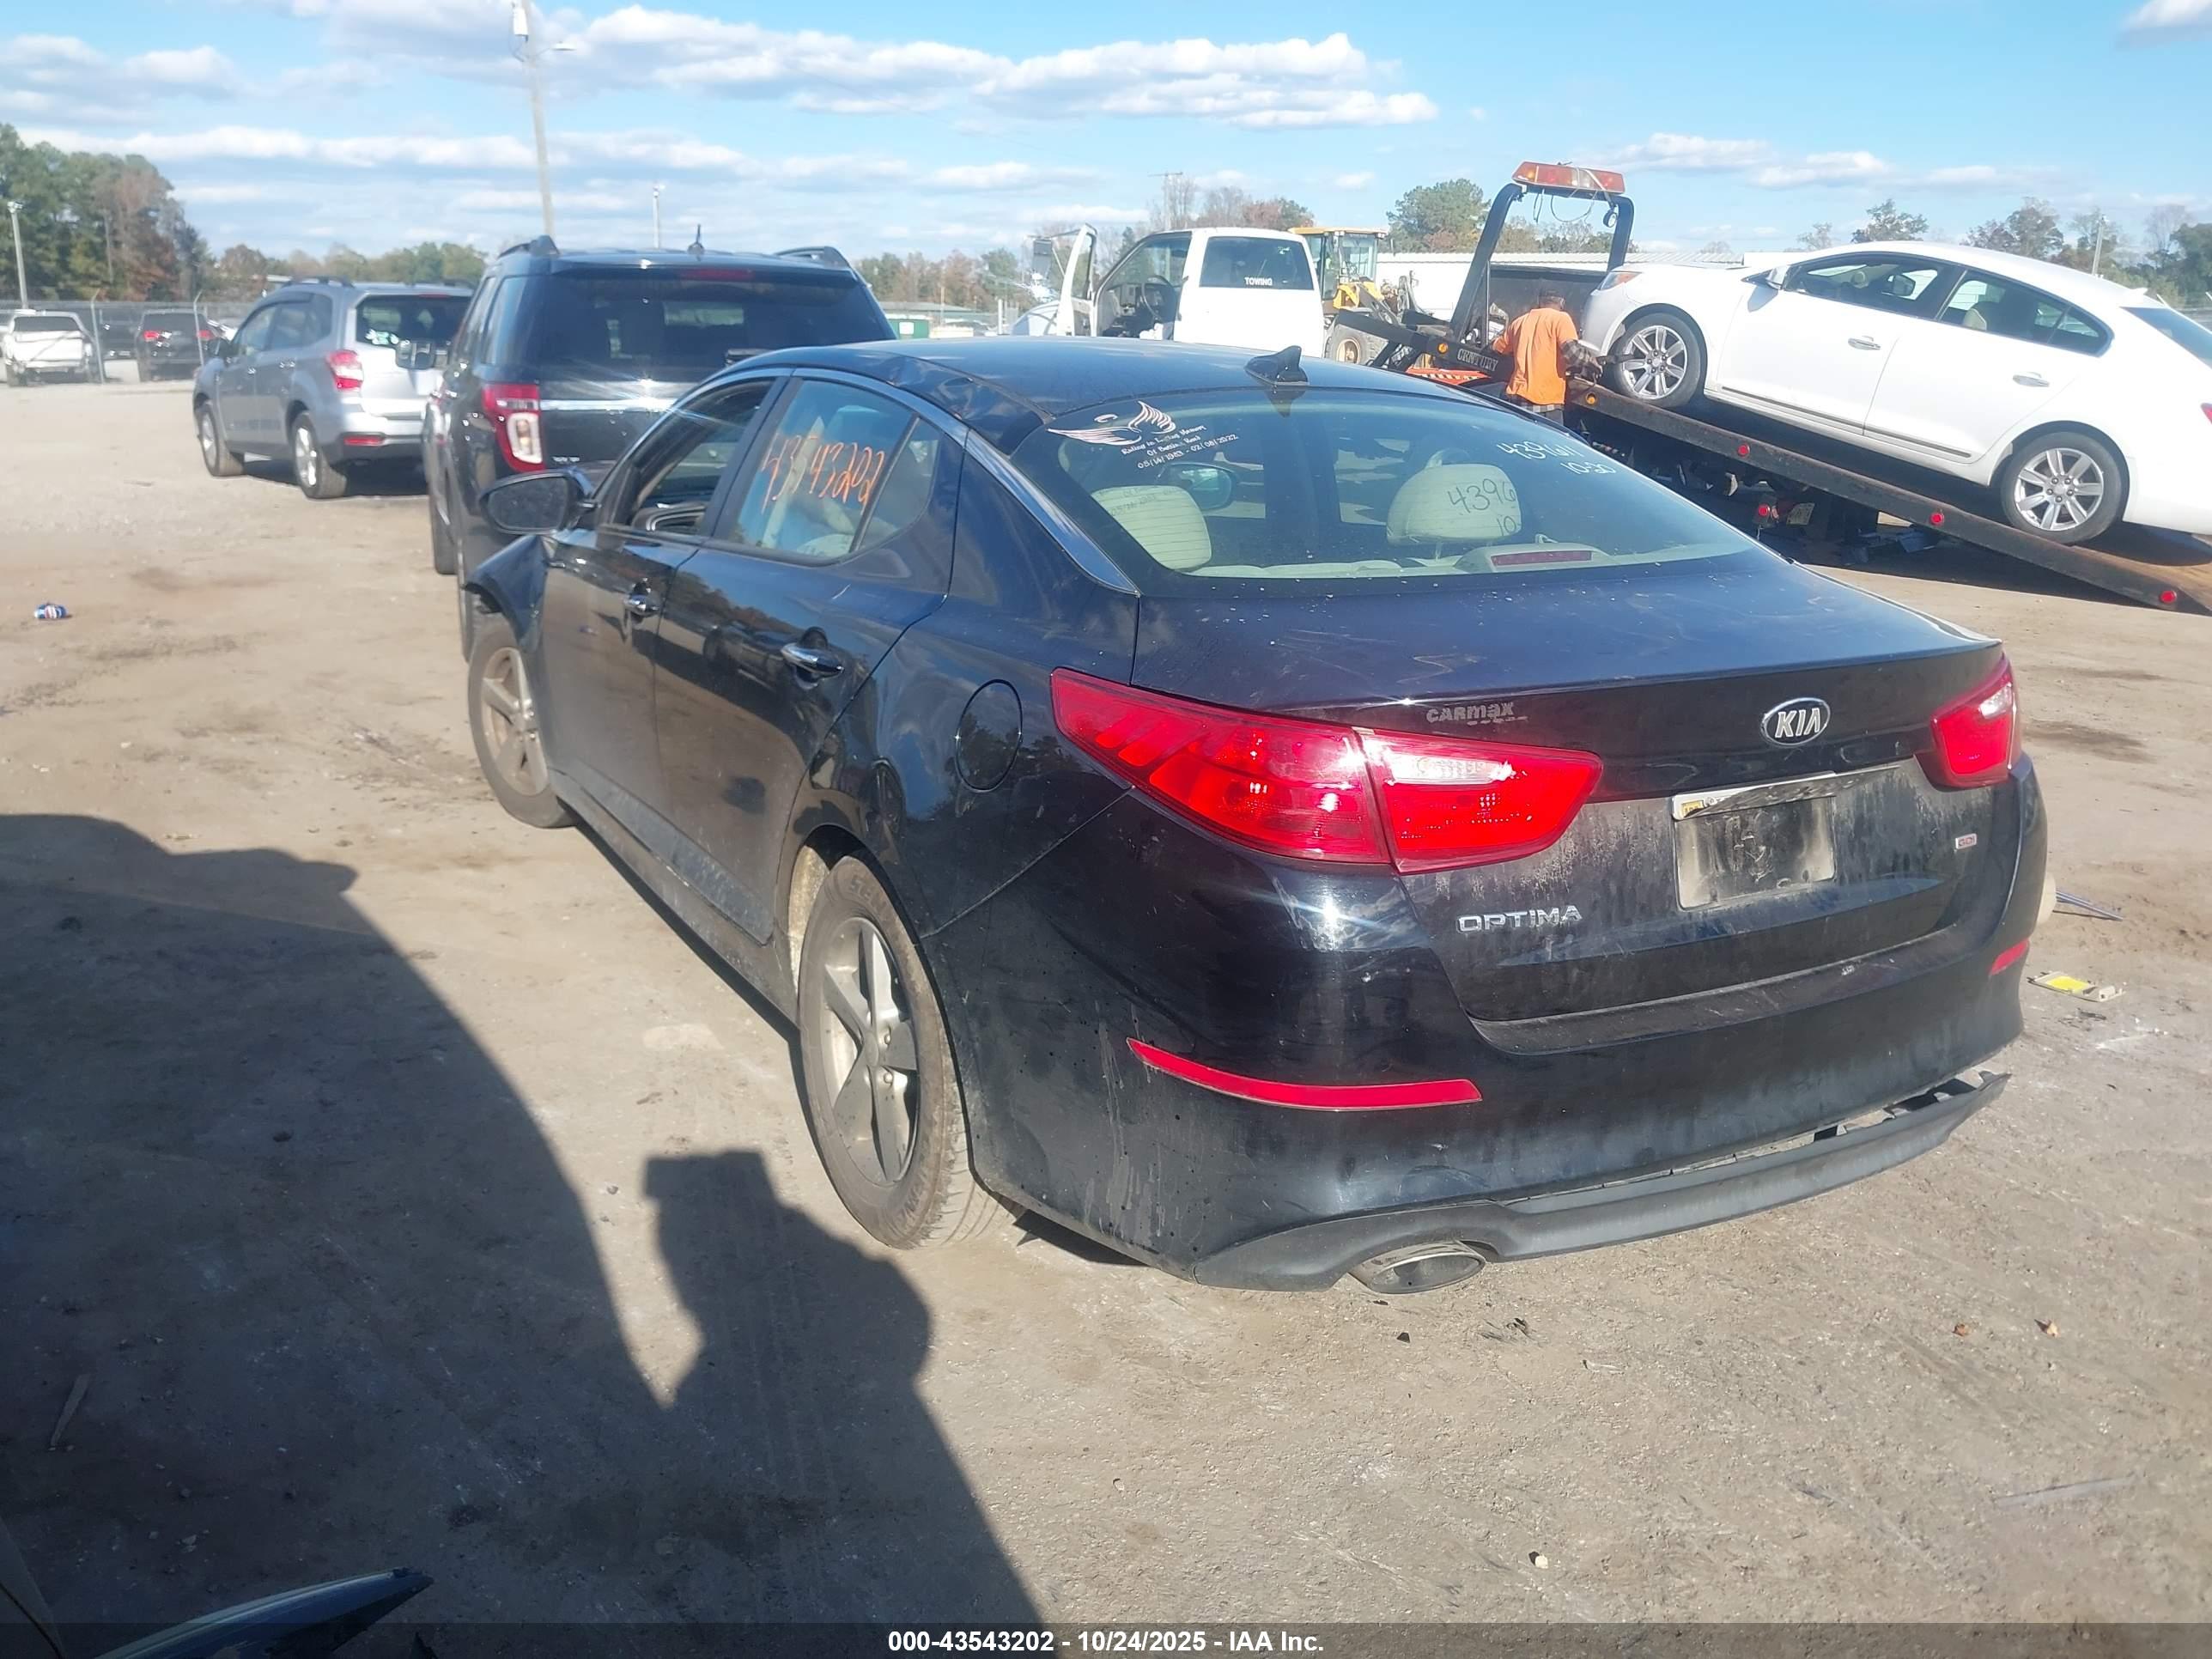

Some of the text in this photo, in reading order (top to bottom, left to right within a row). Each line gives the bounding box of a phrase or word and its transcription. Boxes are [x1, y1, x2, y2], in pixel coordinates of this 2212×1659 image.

[1244, 276, 1273, 286] TOWING
[1456, 349, 1498, 371] CENTURY
[1180, 425, 1206, 435] Memory
[1774, 708, 1821, 738] KIA
[1457, 904, 1583, 933] OPTIMA
